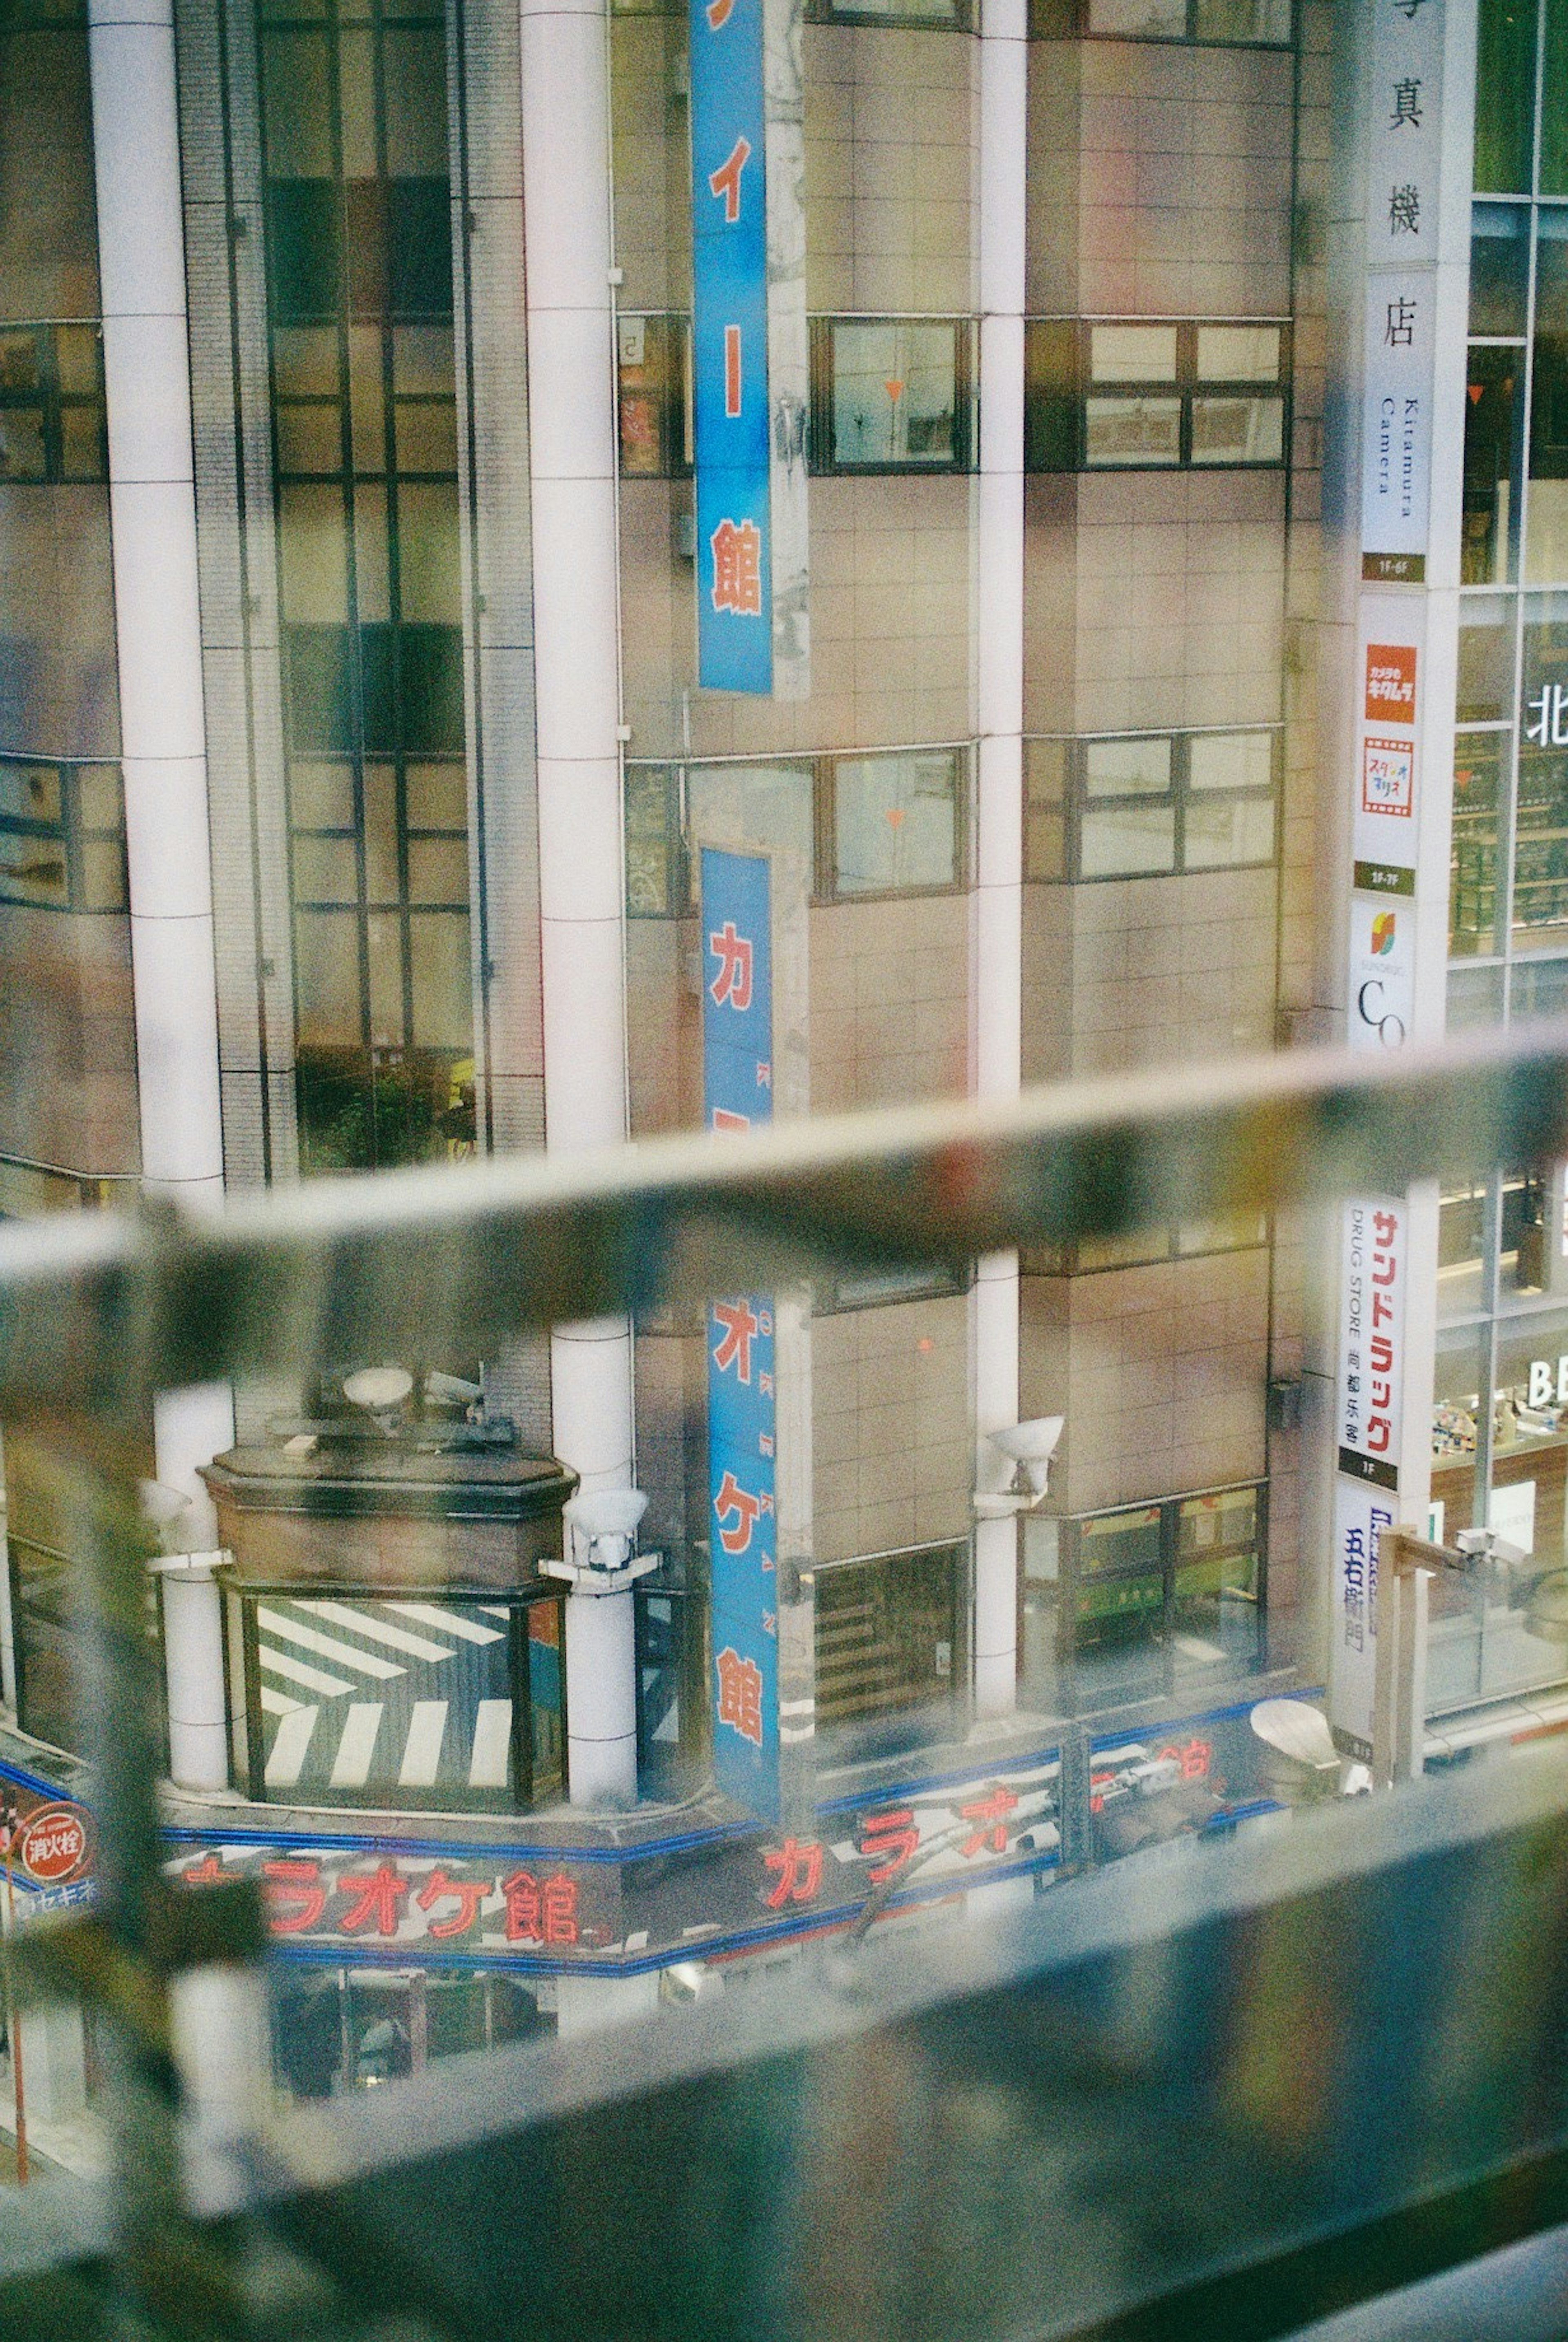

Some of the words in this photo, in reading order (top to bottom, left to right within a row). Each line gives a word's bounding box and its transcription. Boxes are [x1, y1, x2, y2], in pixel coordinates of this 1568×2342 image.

[706, 0, 762, 617] イー館
[1379, 397, 1395, 495] Camera
[1401, 398, 1419, 517] Kitamura
[1368, 680, 1414, 703] キタムラ
[1349, 1209, 1364, 1268] DRUG
[1348, 1276, 1362, 1339] STORE
[29, 1829, 80, 1864] 消火栓
